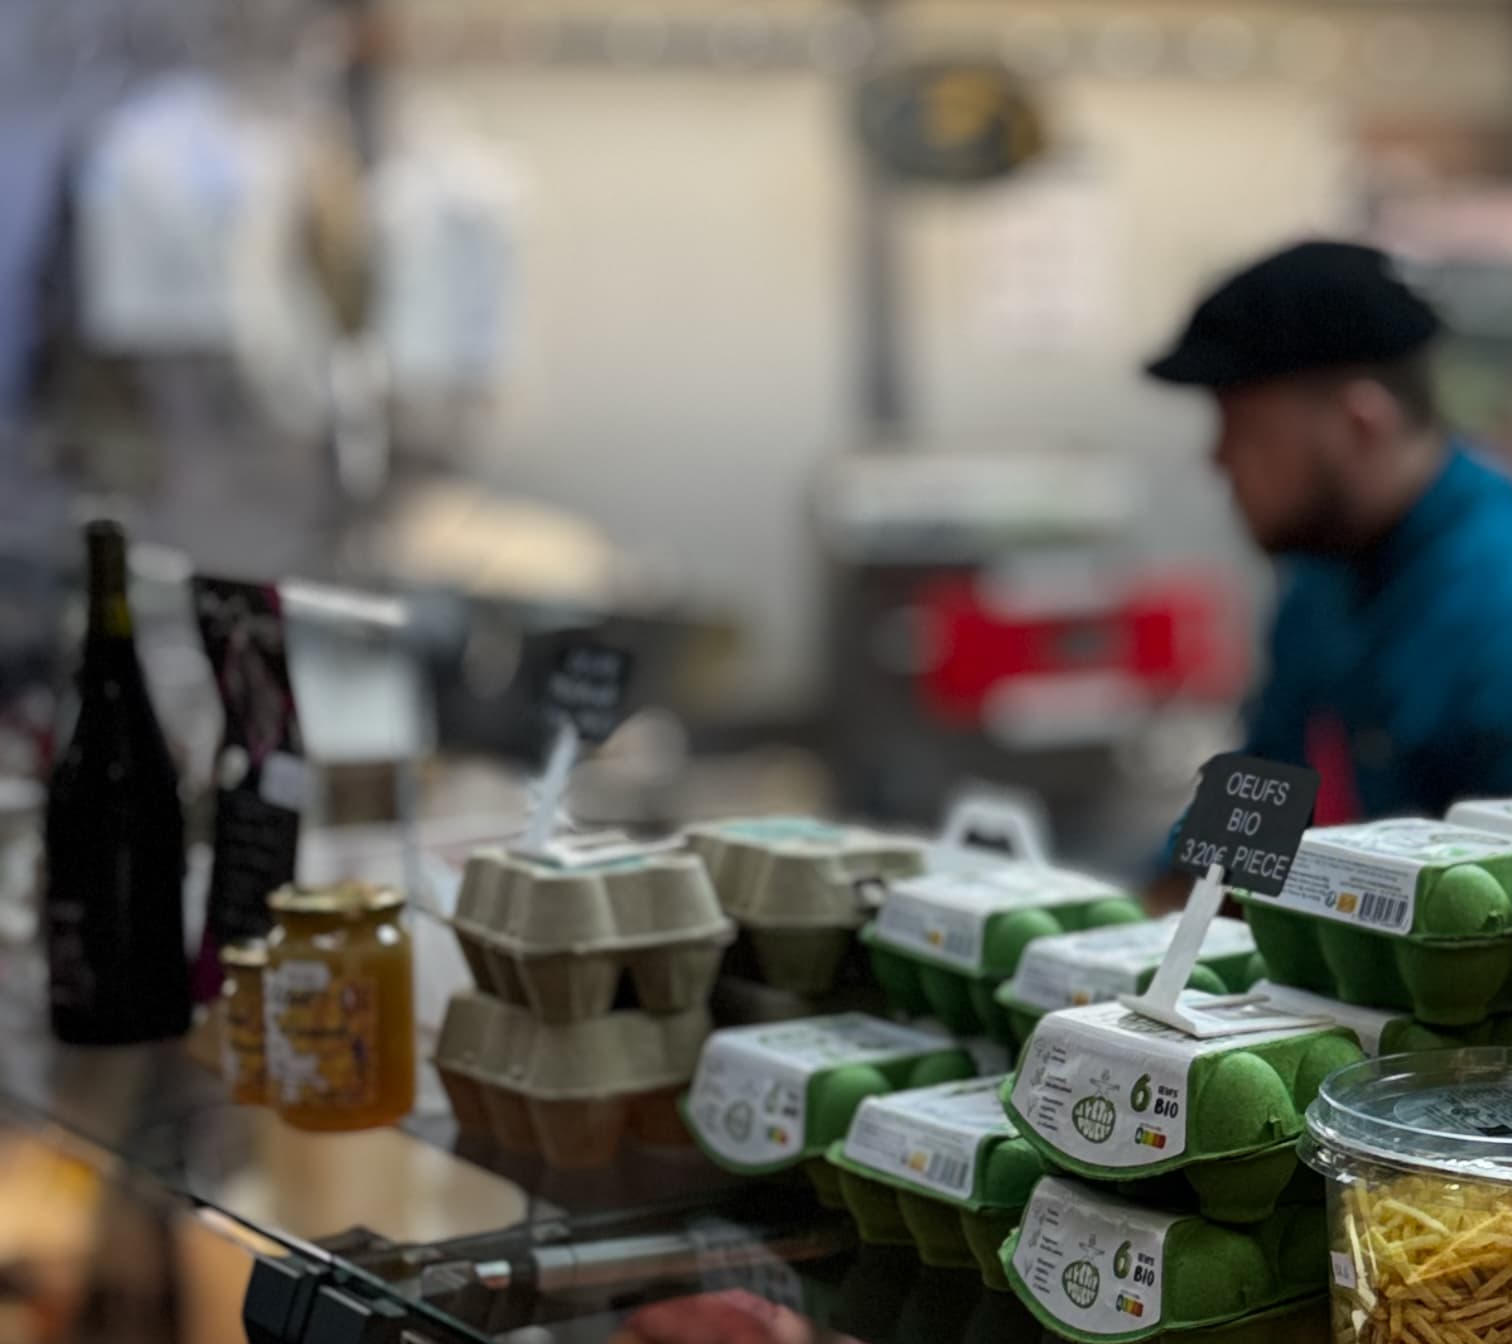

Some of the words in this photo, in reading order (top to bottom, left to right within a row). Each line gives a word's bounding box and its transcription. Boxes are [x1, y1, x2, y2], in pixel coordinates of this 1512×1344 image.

[1226, 770, 1291, 807] OEUFS
[1226, 807, 1263, 837] BIO
[1231, 845, 1291, 881] PIECE
[1130, 1073, 1151, 1113] 6
[1154, 1098, 1179, 1119] BIO
[1113, 1240, 1132, 1279] 6
[1133, 1265, 1155, 1287] BIO
